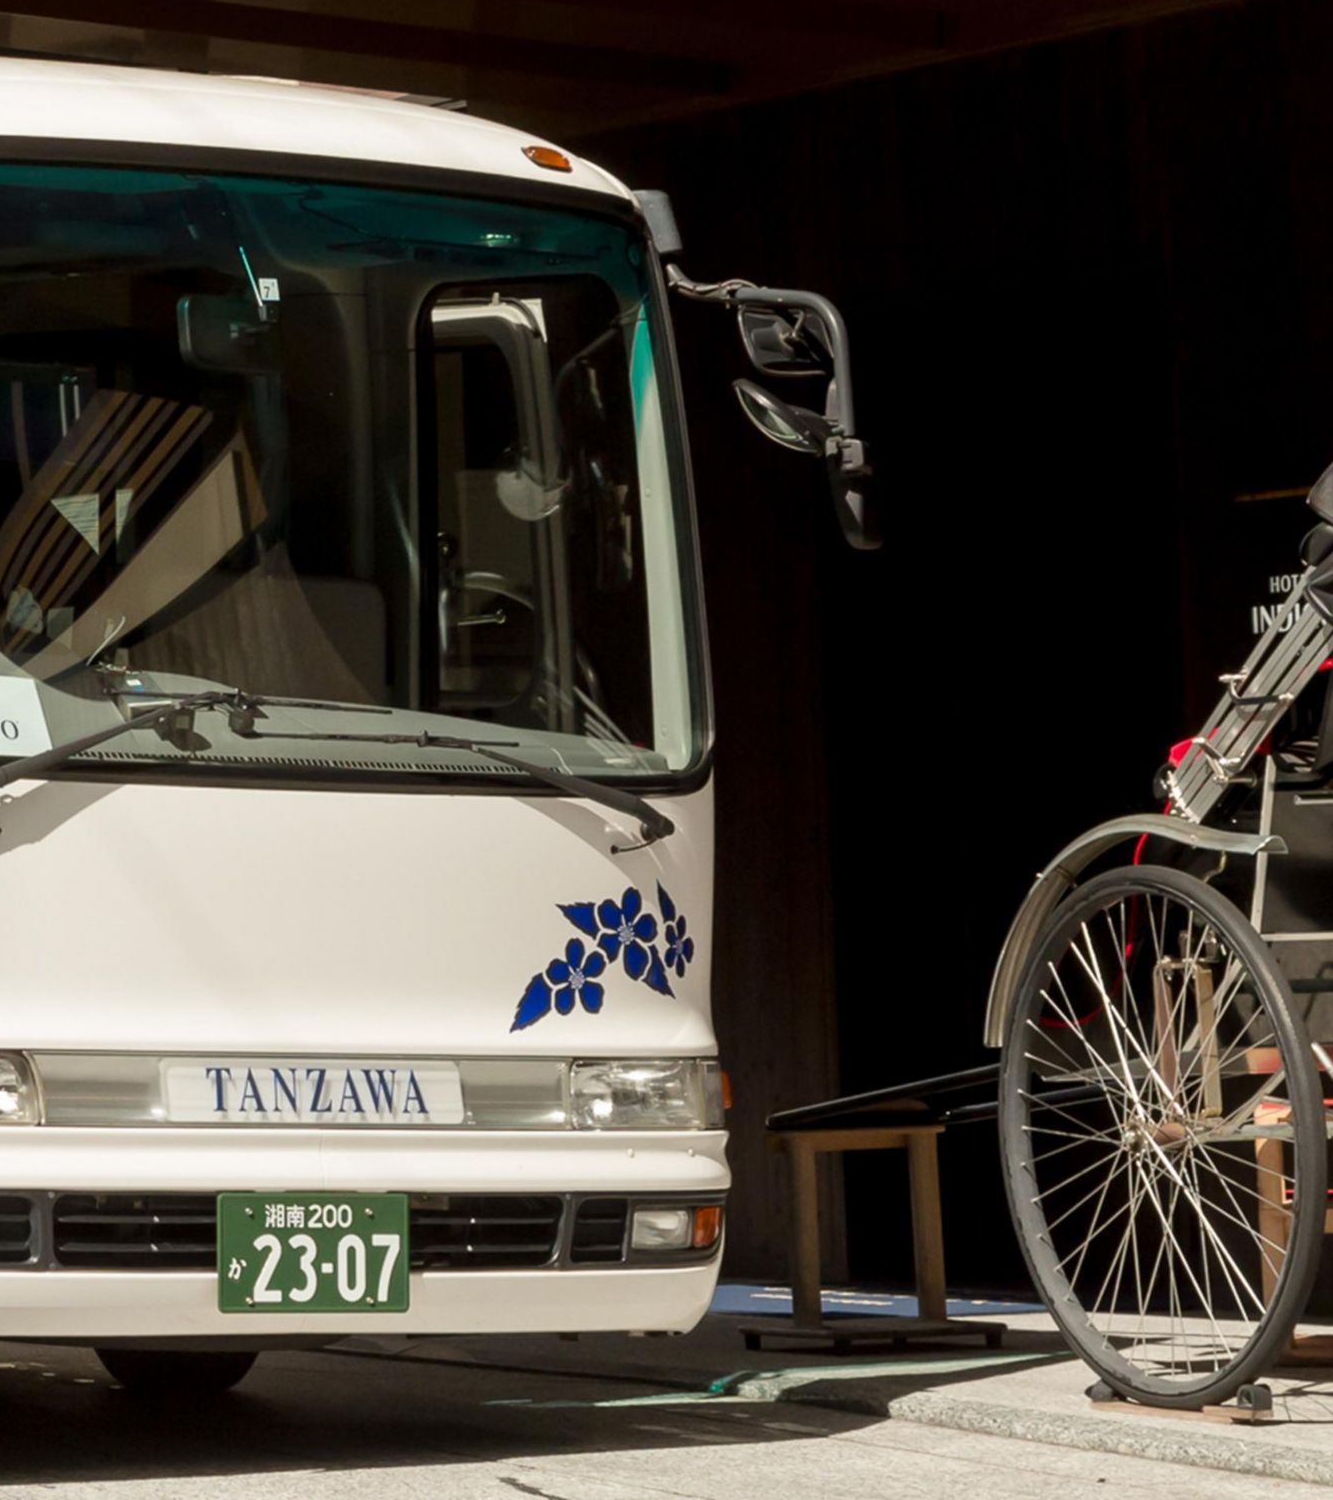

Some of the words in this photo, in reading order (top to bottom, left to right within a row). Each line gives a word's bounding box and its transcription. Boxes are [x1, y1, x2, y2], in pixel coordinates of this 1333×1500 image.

[1270, 574, 1305, 593] HOT
[205, 1067, 430, 1115] TANZAWA
[228, 1257, 247, 1280] か
[252, 1233, 401, 1303] 23-07
